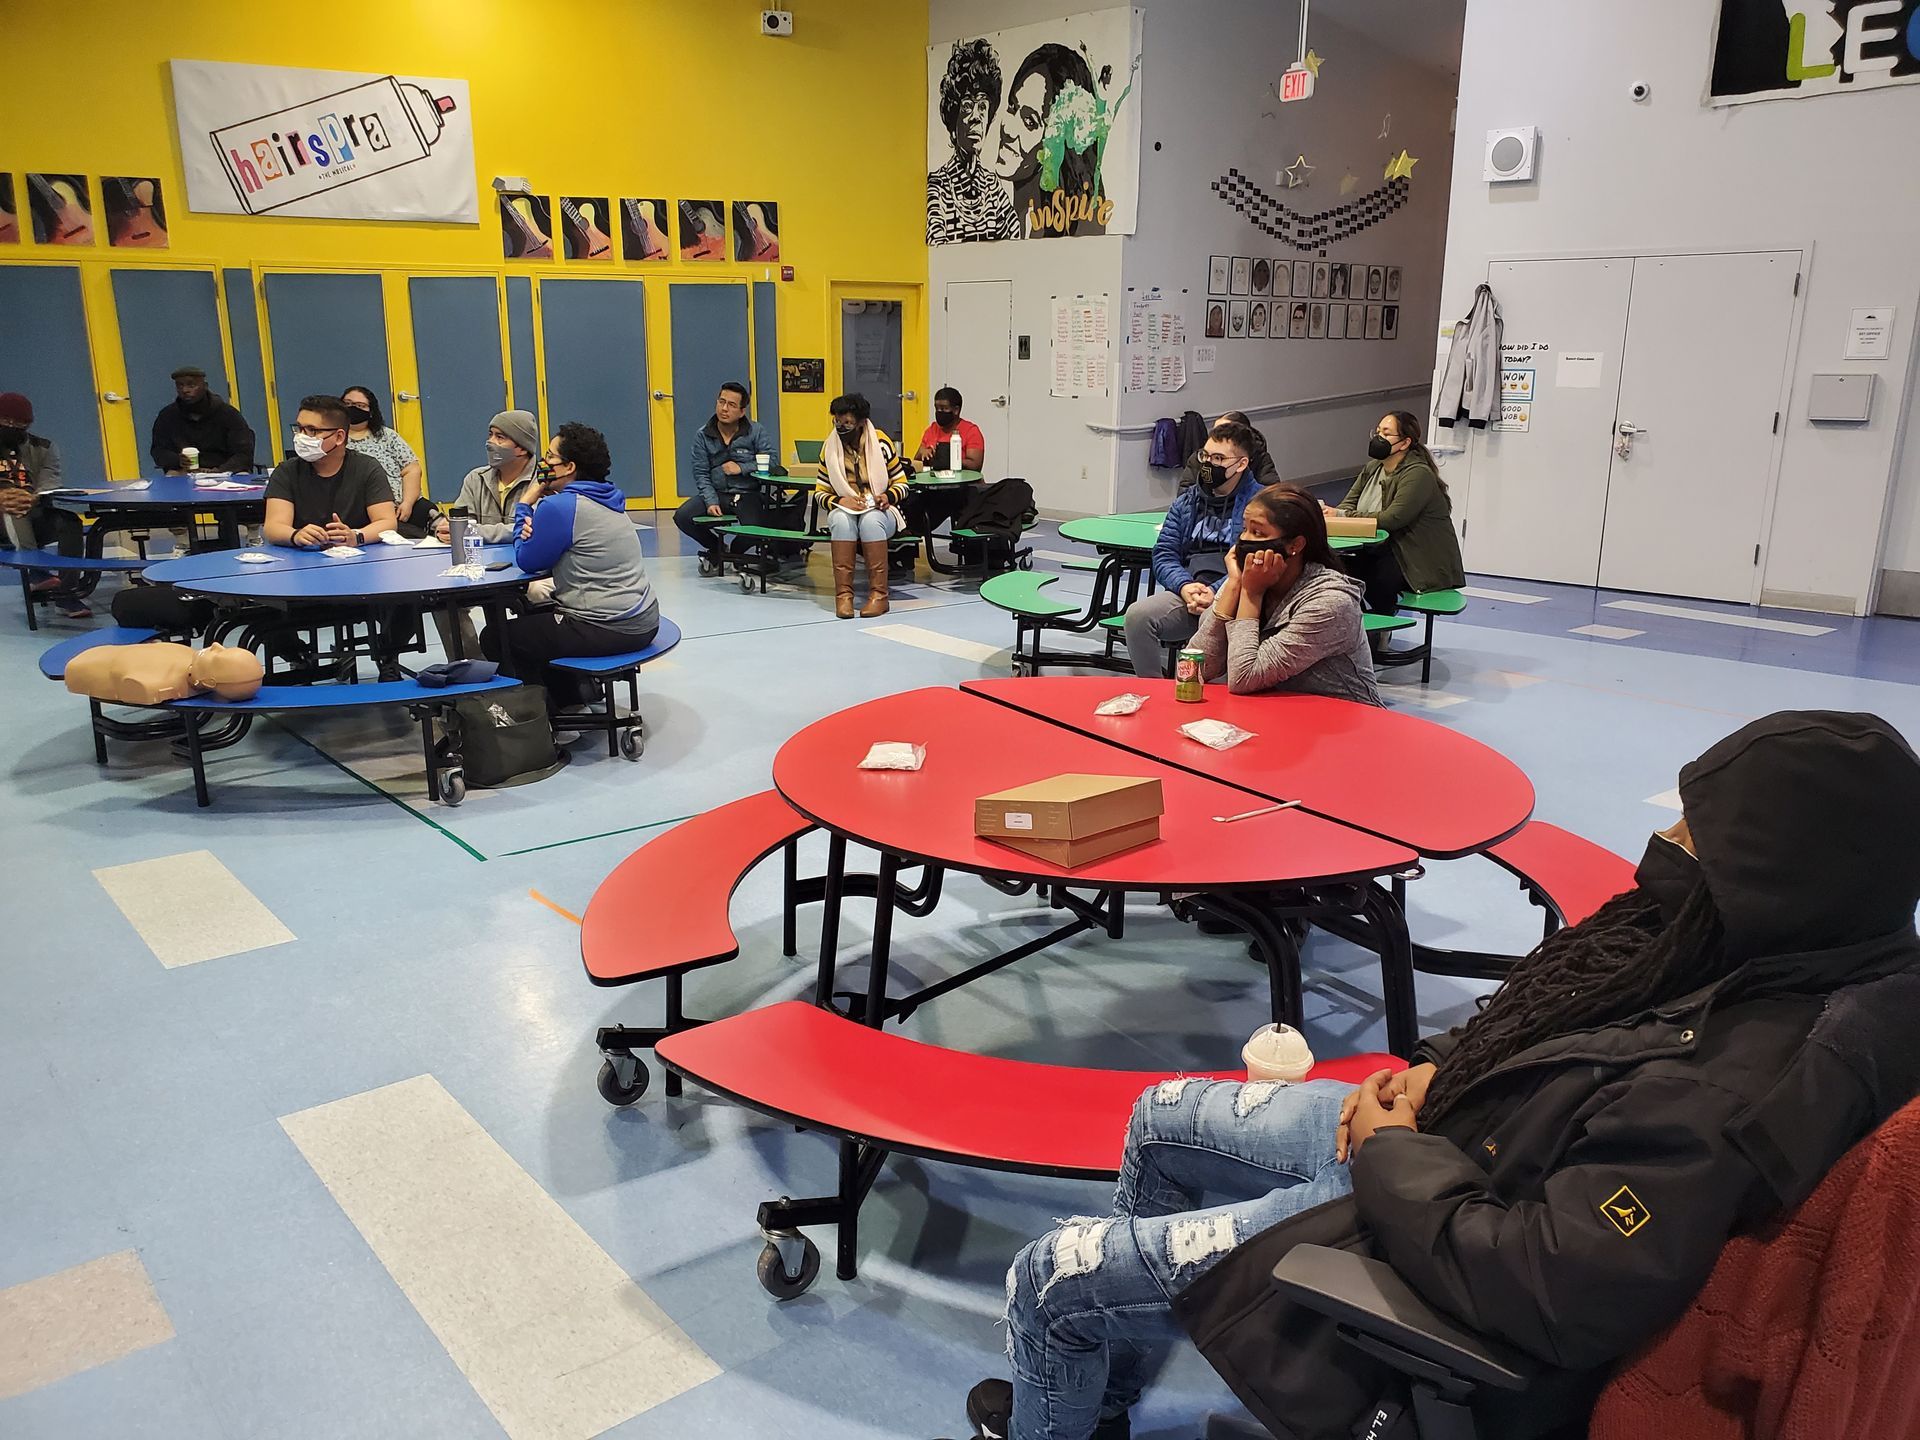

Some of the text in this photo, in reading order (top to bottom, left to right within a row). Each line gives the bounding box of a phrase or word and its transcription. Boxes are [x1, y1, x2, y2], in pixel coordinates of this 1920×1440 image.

[1786, 0, 1920, 81] LE
[1284, 73, 1307, 99] EXIT
[1503, 372, 1527, 381] WOW
